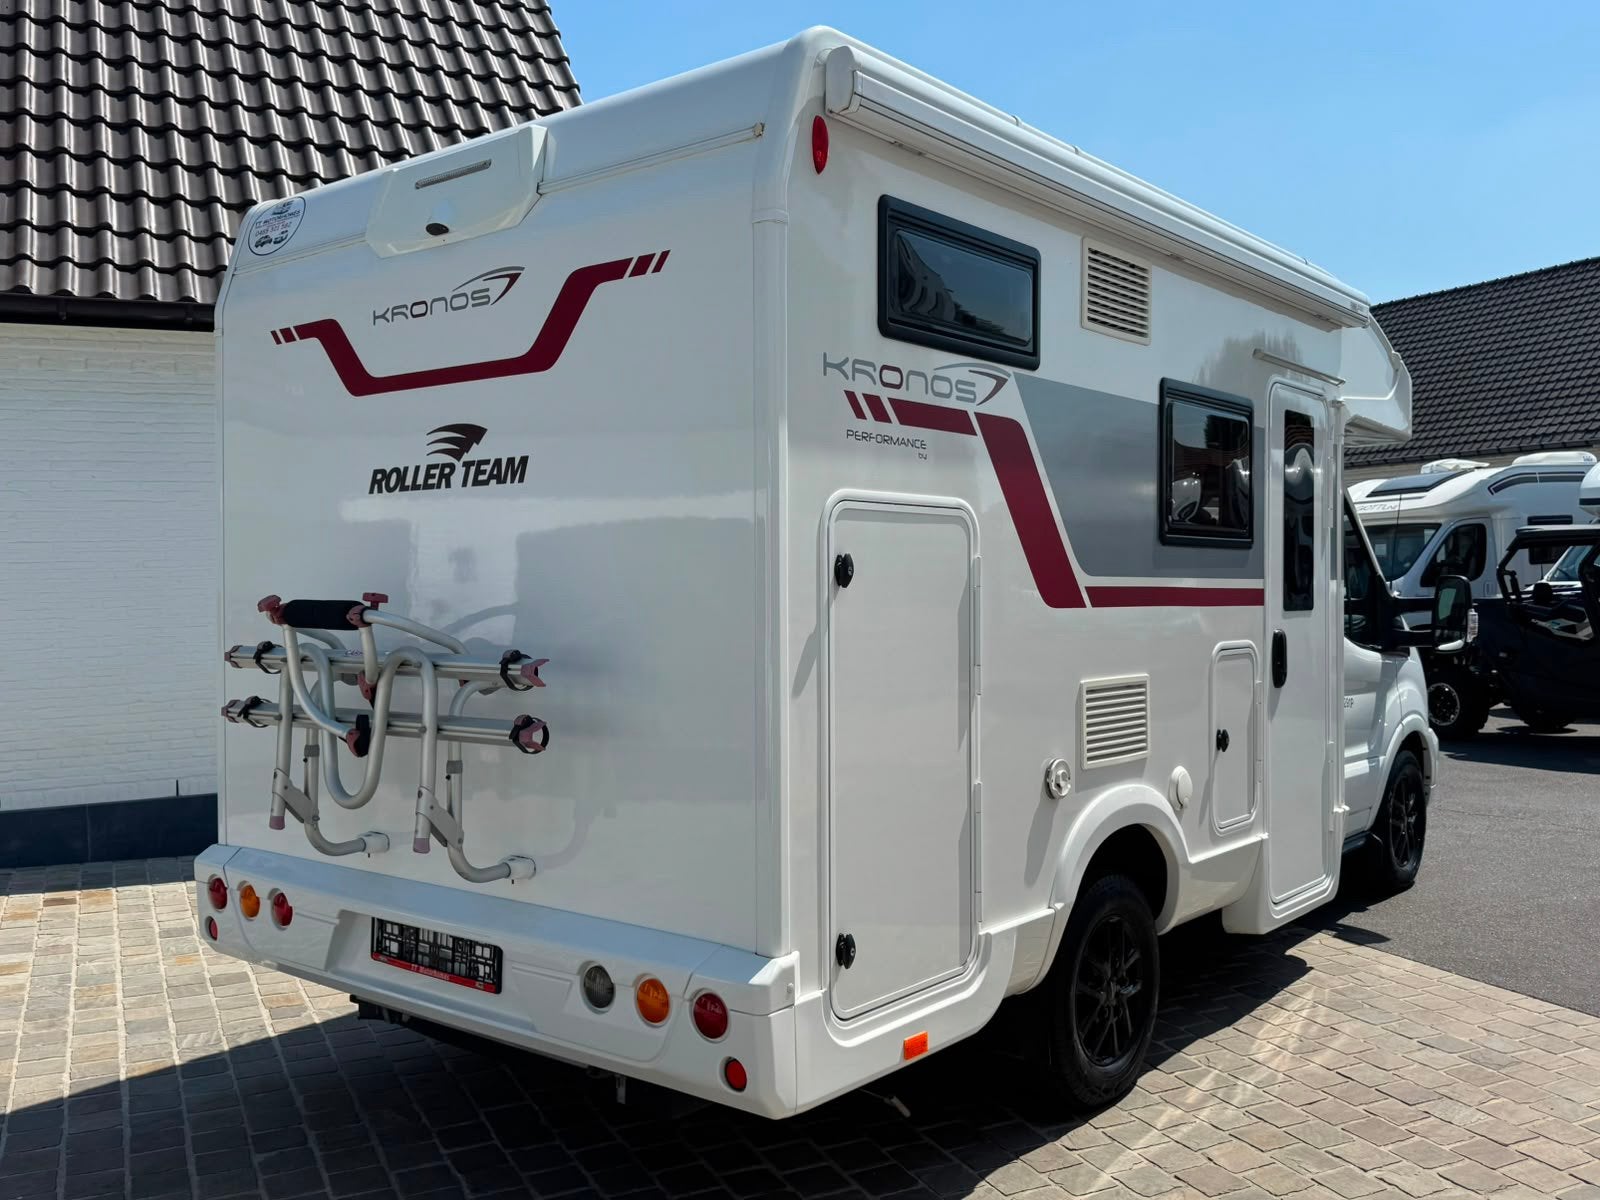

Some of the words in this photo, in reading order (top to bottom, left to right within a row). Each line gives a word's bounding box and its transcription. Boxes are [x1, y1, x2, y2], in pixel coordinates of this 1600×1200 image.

[373, 287, 491, 326] KRONOS
[823, 352, 977, 404] KRONOS
[846, 429, 928, 450] PERFORMANCE
[368, 462, 456, 495] ROLLER
[461, 455, 529, 488] TEAM
